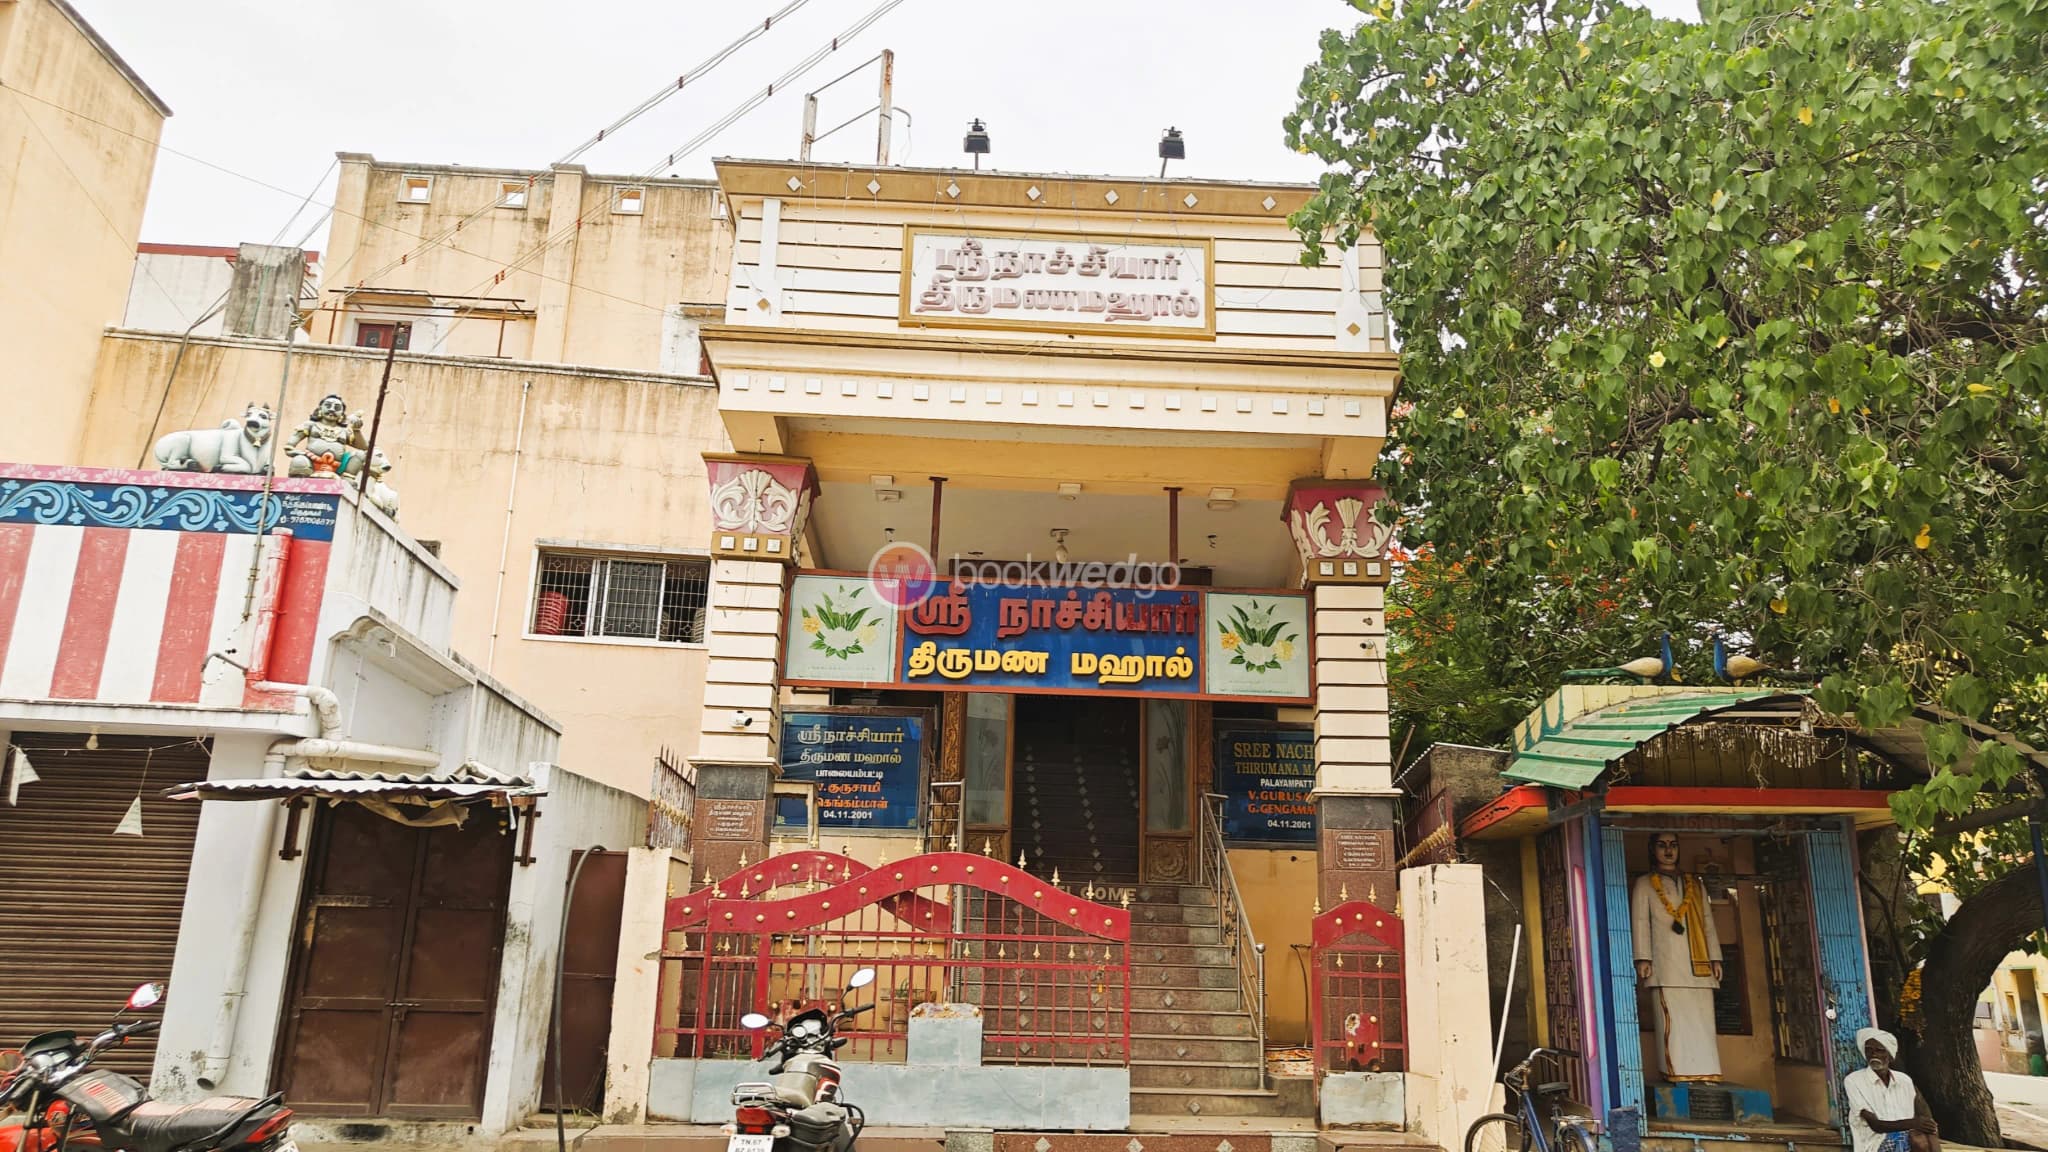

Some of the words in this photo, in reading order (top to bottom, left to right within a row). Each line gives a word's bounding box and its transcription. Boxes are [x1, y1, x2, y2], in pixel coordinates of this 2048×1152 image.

[997, 591, 1199, 638] நாச்சியார்
[908, 641, 1048, 678] திருமண
[1071, 646, 1194, 684] மஹால்
[823, 726, 904, 744] நாச்சியார்
[800, 748, 851, 764] திருமண
[854, 748, 902, 764] மஹால்
[1234, 742, 1271, 758] SREE
[1235, 762, 1300, 775] THIRUMANA
[823, 810, 872, 819] 04.11.2001
[1267, 820, 1311, 829] 04.11.2001
